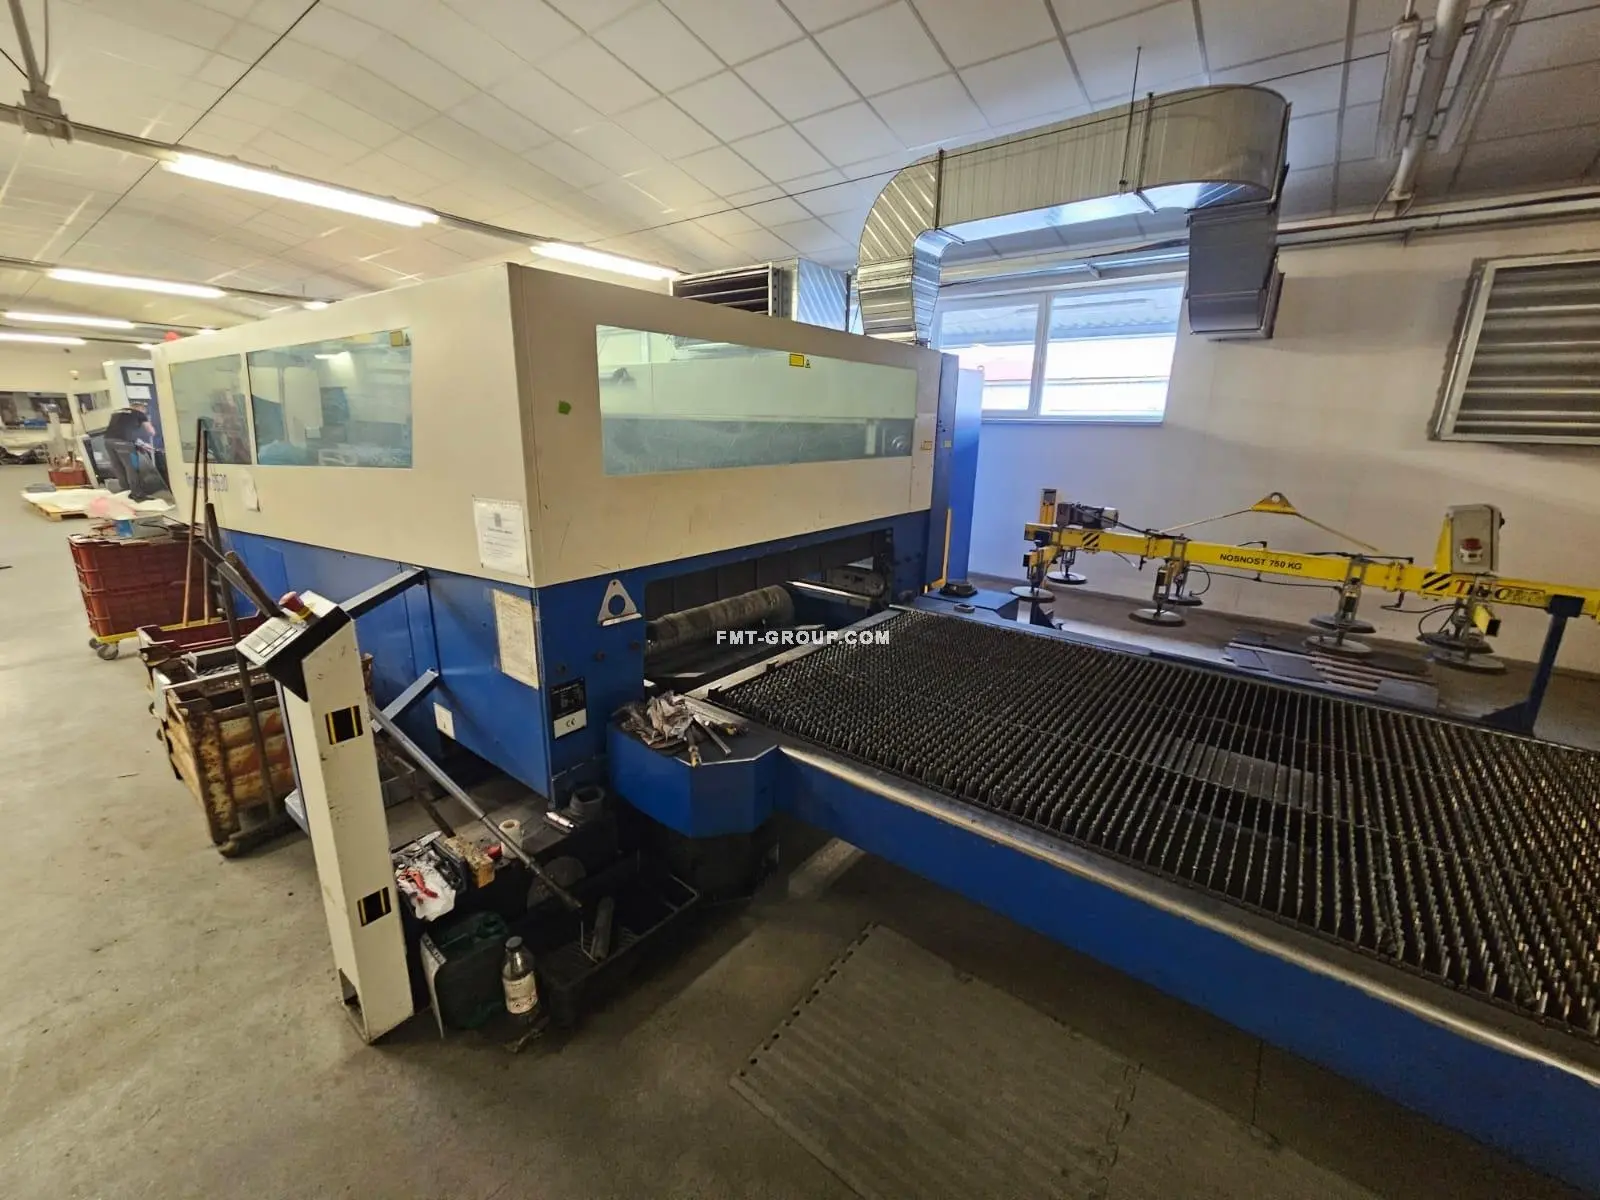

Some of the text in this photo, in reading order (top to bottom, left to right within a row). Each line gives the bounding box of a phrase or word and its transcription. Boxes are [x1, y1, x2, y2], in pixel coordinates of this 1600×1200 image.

[1219, 553, 1303, 570] NOSNOST 750 KG
